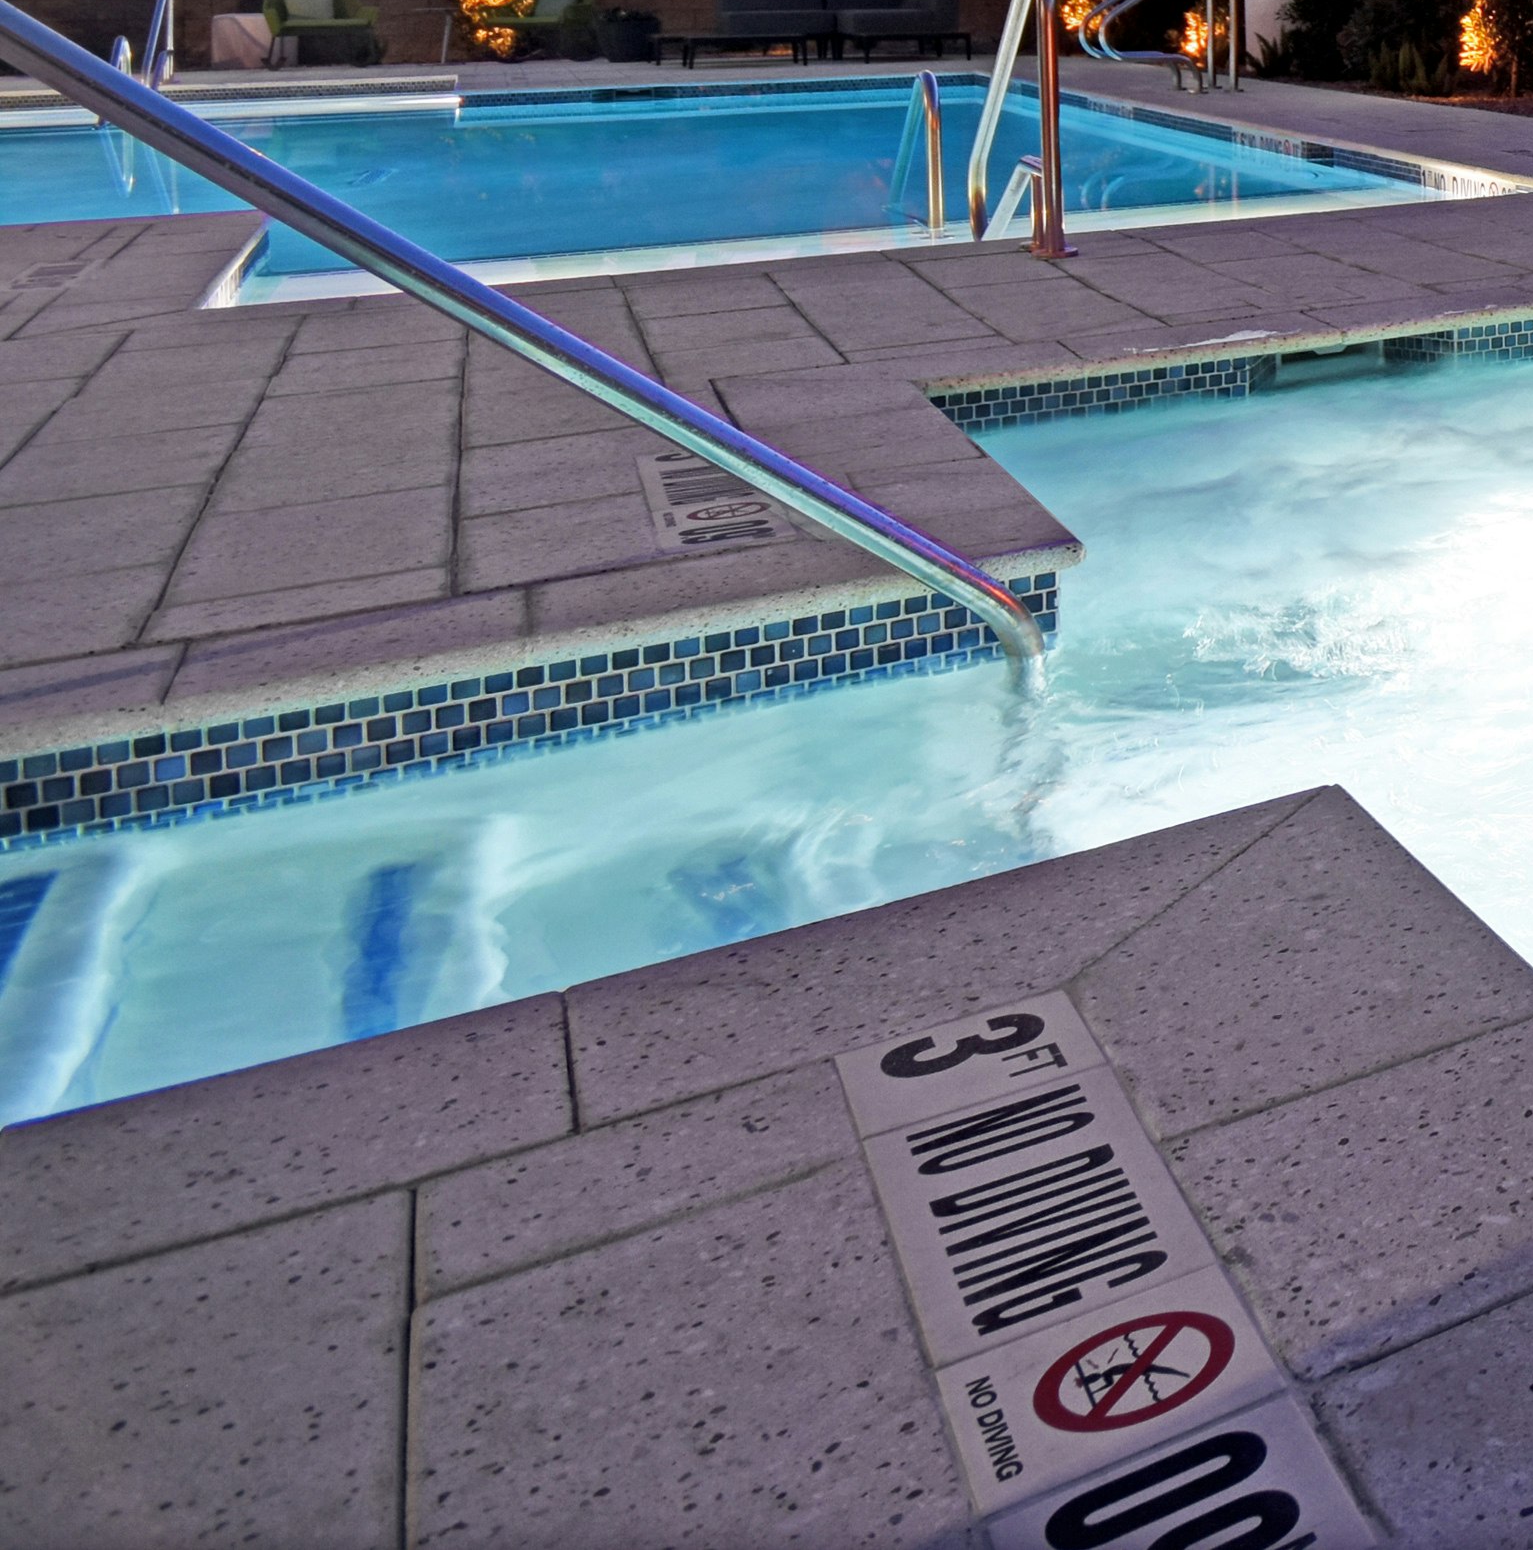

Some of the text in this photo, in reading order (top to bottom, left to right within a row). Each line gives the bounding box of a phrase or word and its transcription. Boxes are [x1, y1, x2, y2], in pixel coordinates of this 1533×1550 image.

[906, 1083, 1095, 1175] NO
[929, 1143, 1168, 1337] DIVING
[965, 1376, 1024, 1483] NO DIVING
